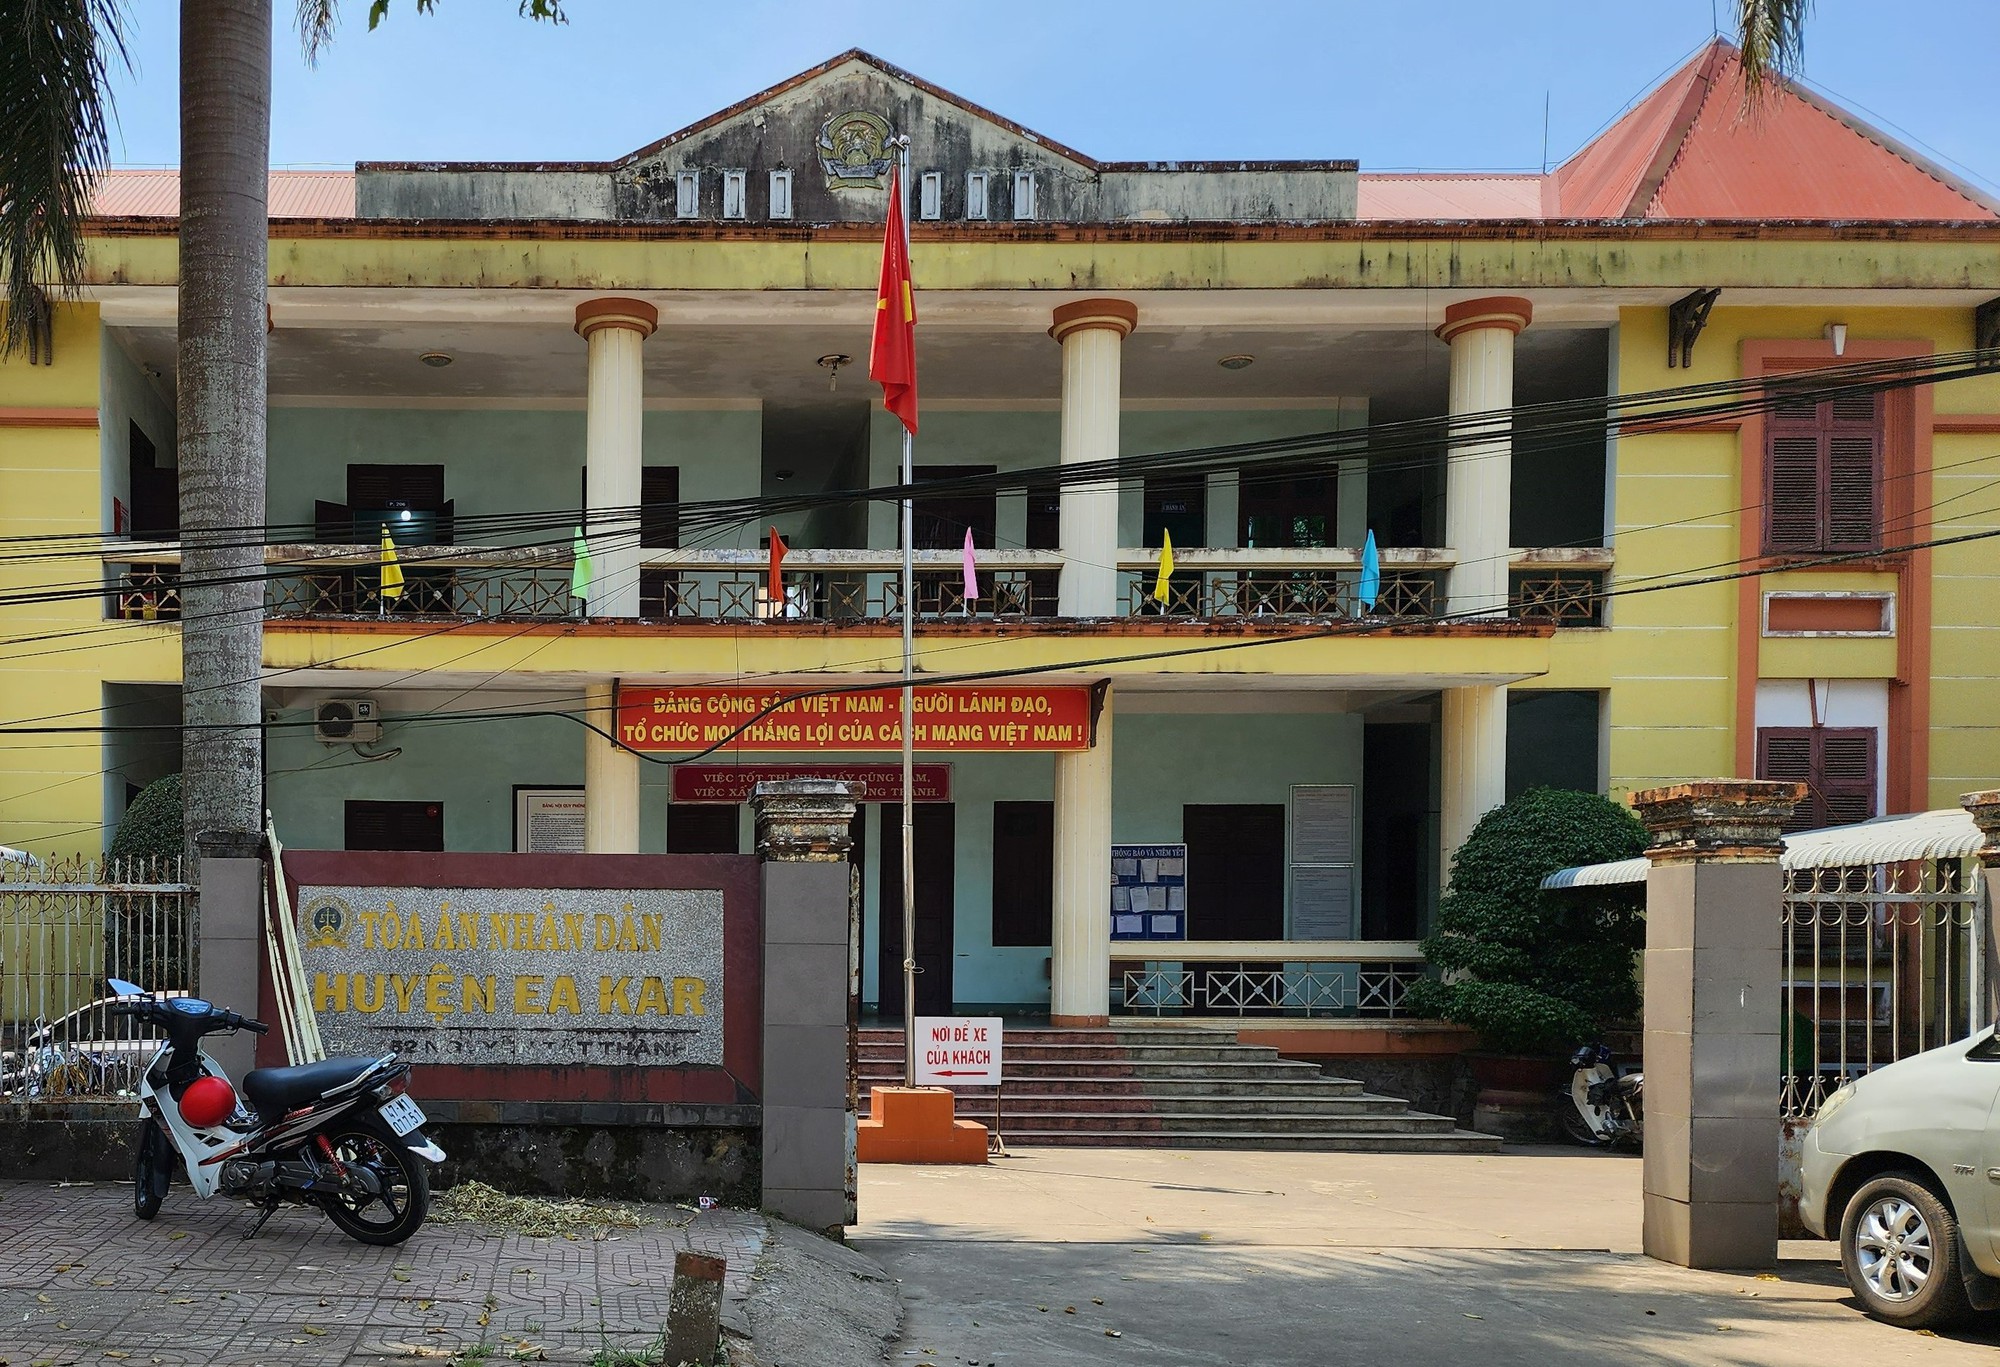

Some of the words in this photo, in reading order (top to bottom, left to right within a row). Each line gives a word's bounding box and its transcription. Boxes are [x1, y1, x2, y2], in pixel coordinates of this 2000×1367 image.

[653, 691, 702, 714] ĐẢNG
[707, 693, 756, 718] CỘNG
[800, 693, 841, 718] VIỆT
[845, 696, 884, 713] NAM
[959, 692, 1006, 713] LÃNH
[1010, 696, 1053, 718] ĐẠO,
[623, 717, 647, 742] TỔ
[651, 721, 700, 742] CHỨC
[704, 725, 736, 746] MỌI
[743, 718, 801, 742] THẮNG
[806, 722, 834, 746] LỢI
[838, 719, 875, 742] CỦA
[879, 720, 927, 742] CÁH
[931, 724, 983, 746] MẠNG
[988, 722, 1029, 747] VIỆT
[1033, 725, 1073, 742] NAM
[1077, 725, 1083, 742] !
[703, 772, 734, 784] VIỆC
[859, 772, 895, 783] CŨNG
[694, 786, 725, 798] VIỆC
[358, 900, 425, 951] TÒA
[432, 901, 481, 951] ÁN
[488, 902, 585, 951] NHÂN
[593, 902, 664, 951] DÂN
[313, 962, 497, 1022] HUYỆN
[513, 975, 582, 1015] EA
[600, 975, 707, 1016] KAR
[932, 1025, 950, 1042] NƠI
[954, 1020, 971, 1042] ĐỂ
[973, 1027, 988, 1042] XE
[926, 1045, 949, 1065] CỦA
[952, 1046, 991, 1065] KHÁCH
